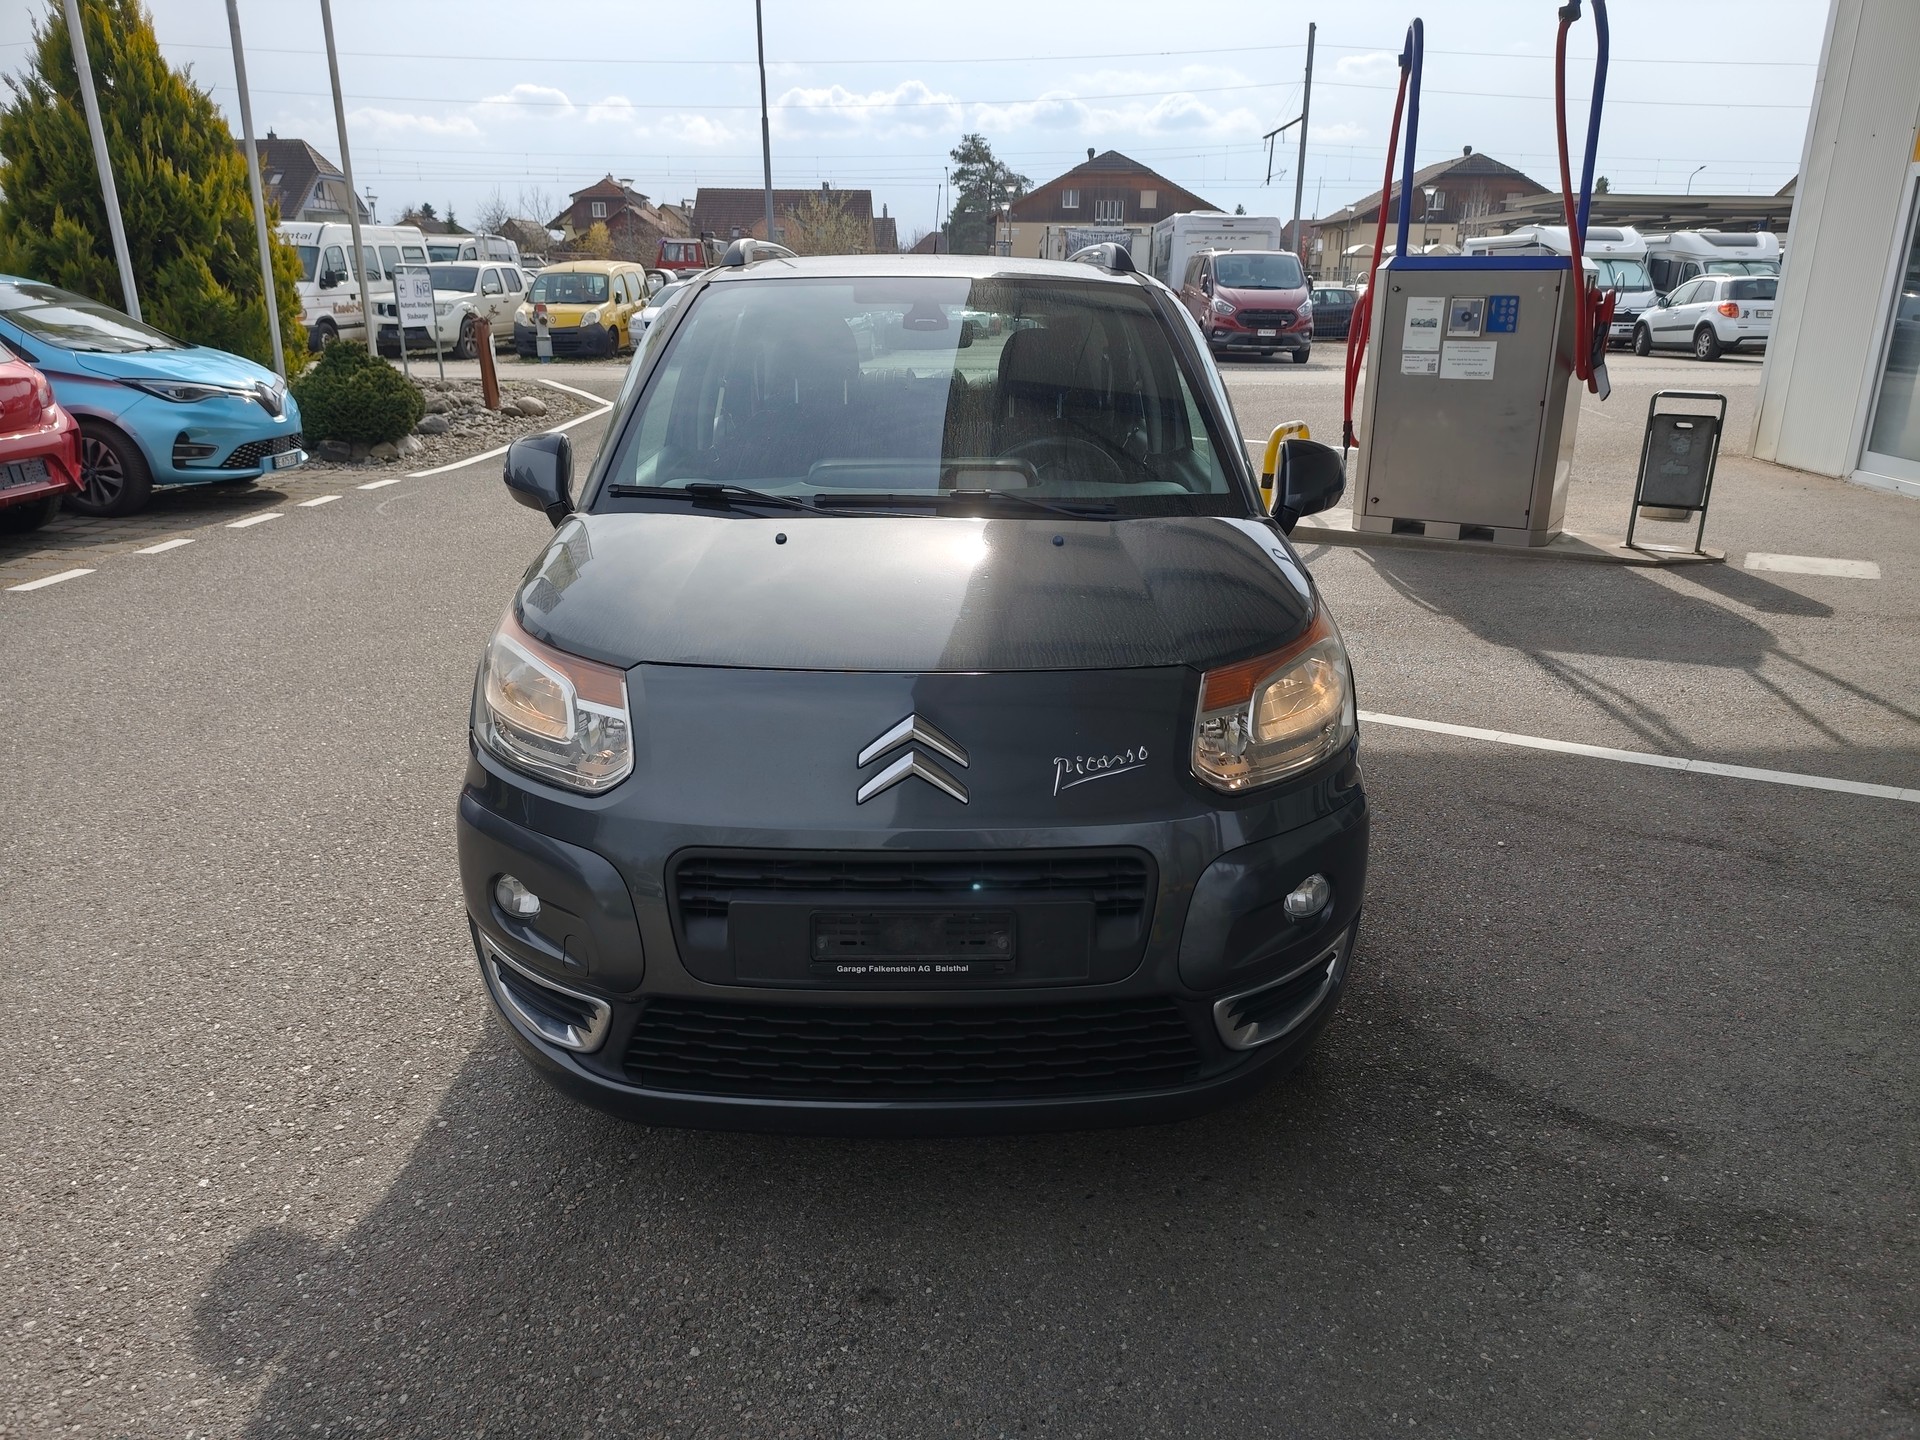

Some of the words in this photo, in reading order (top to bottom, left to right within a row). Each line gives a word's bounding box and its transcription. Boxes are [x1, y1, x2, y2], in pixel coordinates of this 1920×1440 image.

[836, 965, 867, 974] Garage
[868, 965, 916, 973] Falkenstein
[917, 965, 931, 973] AG
